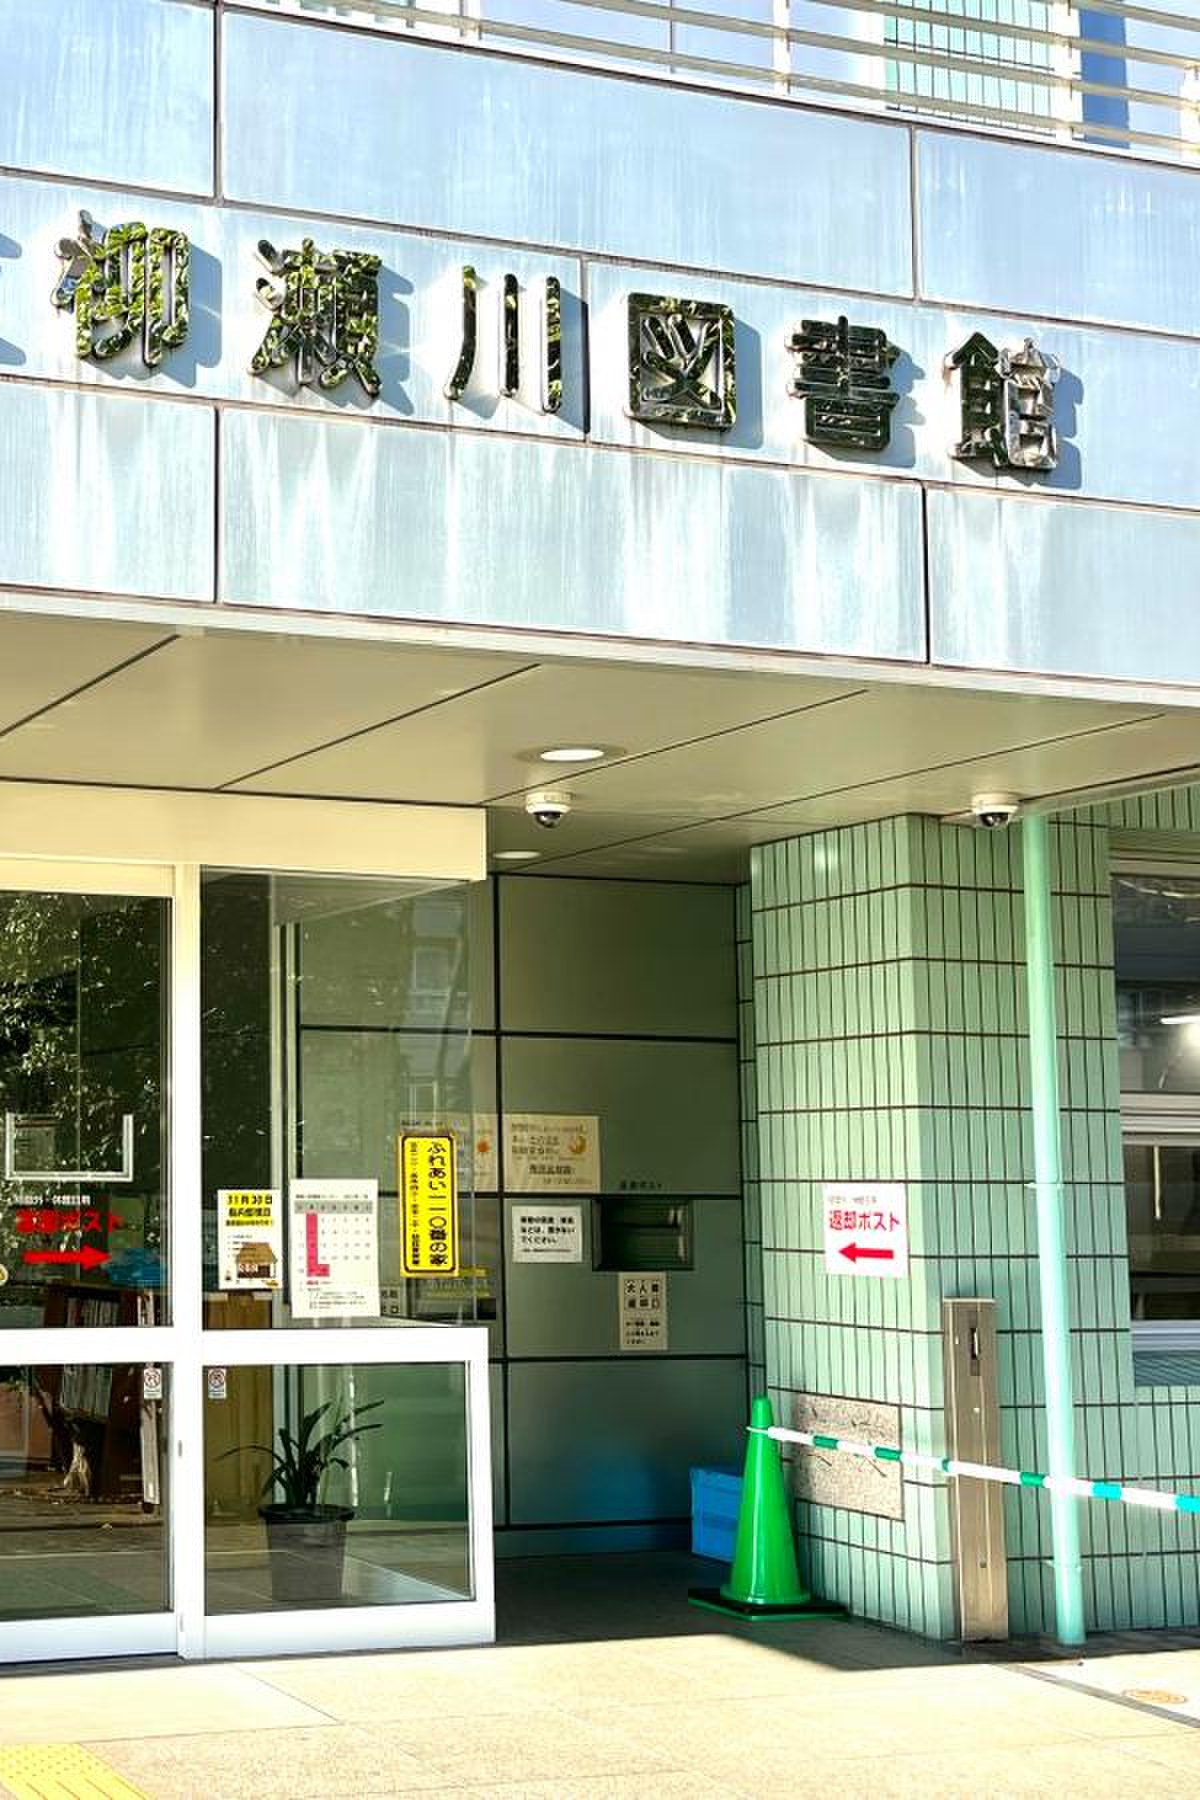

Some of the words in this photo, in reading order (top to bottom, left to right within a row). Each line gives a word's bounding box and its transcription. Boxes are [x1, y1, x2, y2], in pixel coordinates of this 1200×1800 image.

[828, 1209, 900, 1232] 返却ポスト
